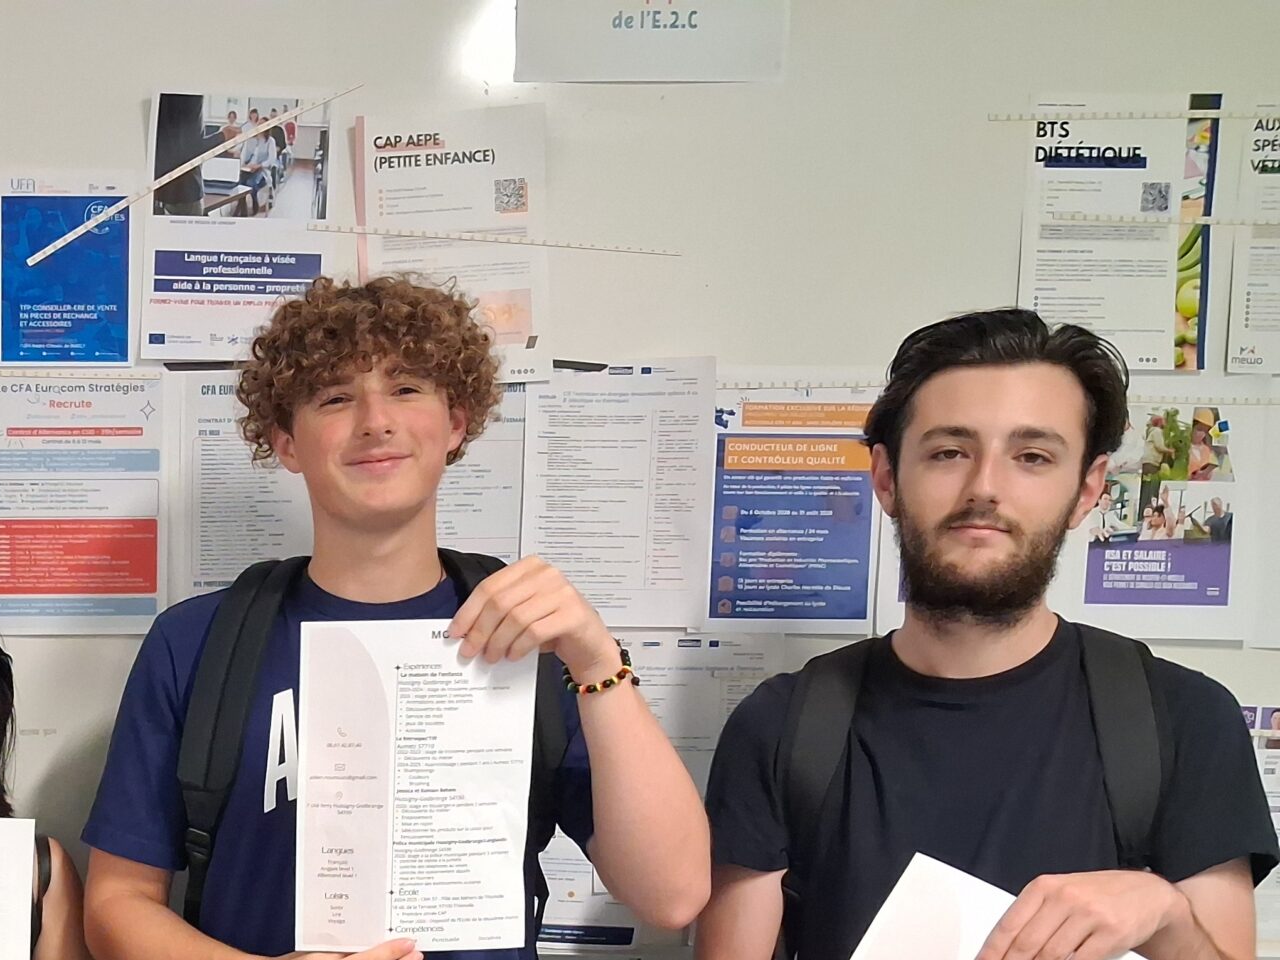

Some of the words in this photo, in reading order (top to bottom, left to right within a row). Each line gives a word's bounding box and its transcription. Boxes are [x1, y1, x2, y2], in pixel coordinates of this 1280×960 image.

[612, 10, 634, 29] de
[640, 10, 698, 29] l'E.2.C
[1036, 121, 1070, 138] BTS
[373, 135, 402, 149] CAP
[405, 133, 440, 147] AEPE
[1253, 135, 1280, 151] SPÉ
[1035, 140, 1142, 164] DIÉTÉTIQUE
[374, 155, 421, 173] (PETITE
[426, 149, 495, 166] ENFANCE)
[185, 253, 218, 263] Langue
[220, 254, 262, 264] française
[264, 254, 270, 263] à
[273, 255, 296, 264] visée
[203, 265, 273, 275] professionnelle
[173, 281, 192, 290] aide
[194, 281, 200, 290] à
[203, 282, 211, 290] la
[213, 283, 255, 292] personne
[266, 283, 306, 293] propreté
[1231, 357, 1263, 365] mewo
[11, 384, 32, 393] CFA
[35, 384, 85, 394] Eurocom
[88, 383, 145, 395] Stratégies
[201, 385, 216, 395] CFA
[219, 385, 233, 395] EUR
[49, 400, 92, 408] Recrute
[728, 443, 793, 451] CONDUCTEUR
[811, 444, 838, 452] LIGNE
[741, 455, 804, 465] CONTRÔLEUR
[807, 456, 845, 465] QUALITÉ
[1122, 550, 1132, 560] ET
[1104, 562, 1127, 571] C'EST
[263, 689, 298, 813] A
[321, 847, 354, 856] Langues
[325, 892, 349, 900] Loisirs
[399, 888, 420, 896] École
[395, 926, 444, 934] Compétences
